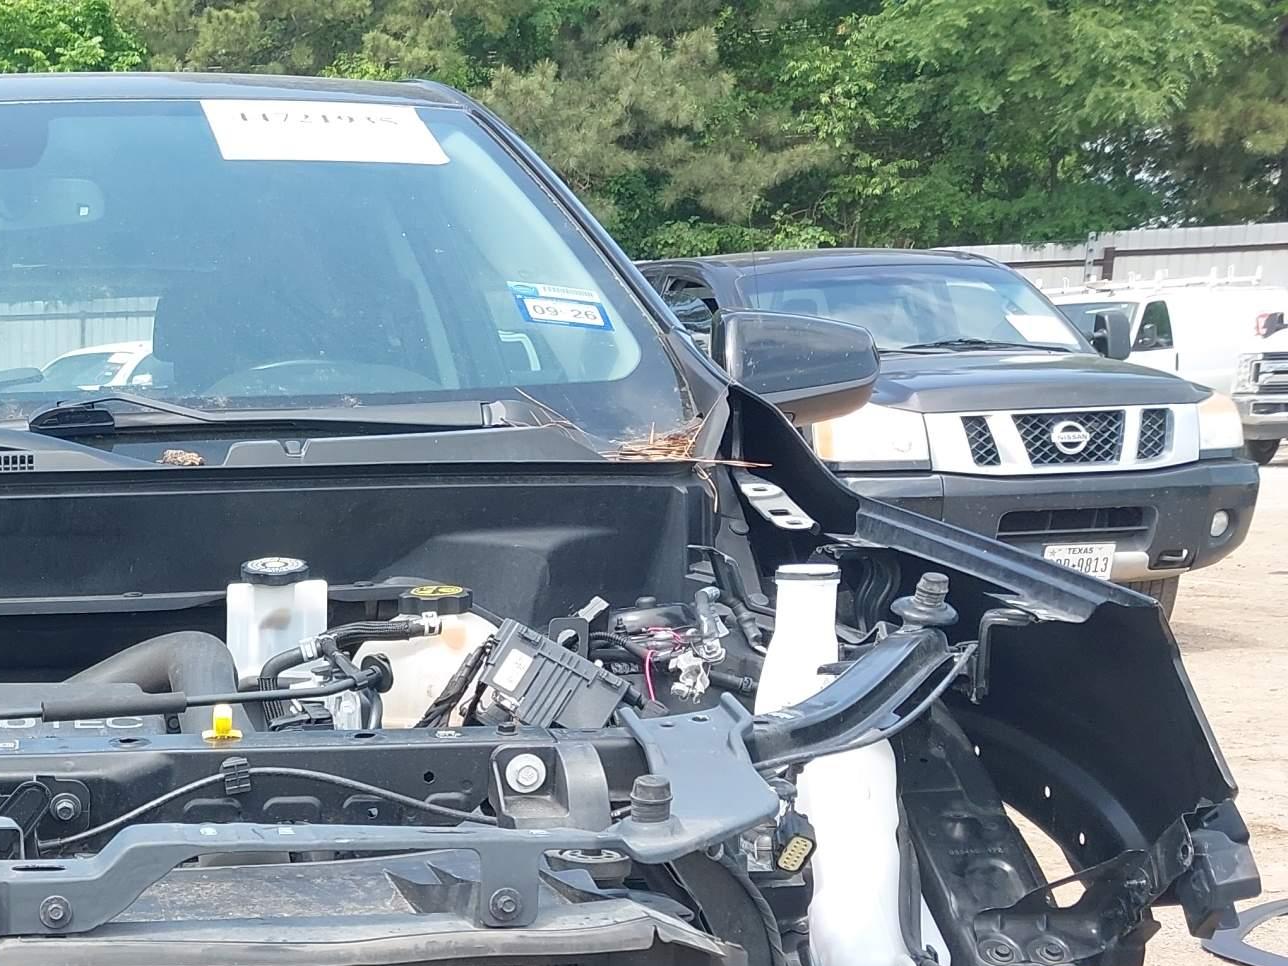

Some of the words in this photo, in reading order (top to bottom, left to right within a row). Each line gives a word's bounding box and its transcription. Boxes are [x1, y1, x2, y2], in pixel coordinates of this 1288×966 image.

[532, 304, 559, 317] 09
[570, 308, 598, 322] 26
[1067, 547, 1094, 555] TEXAS
